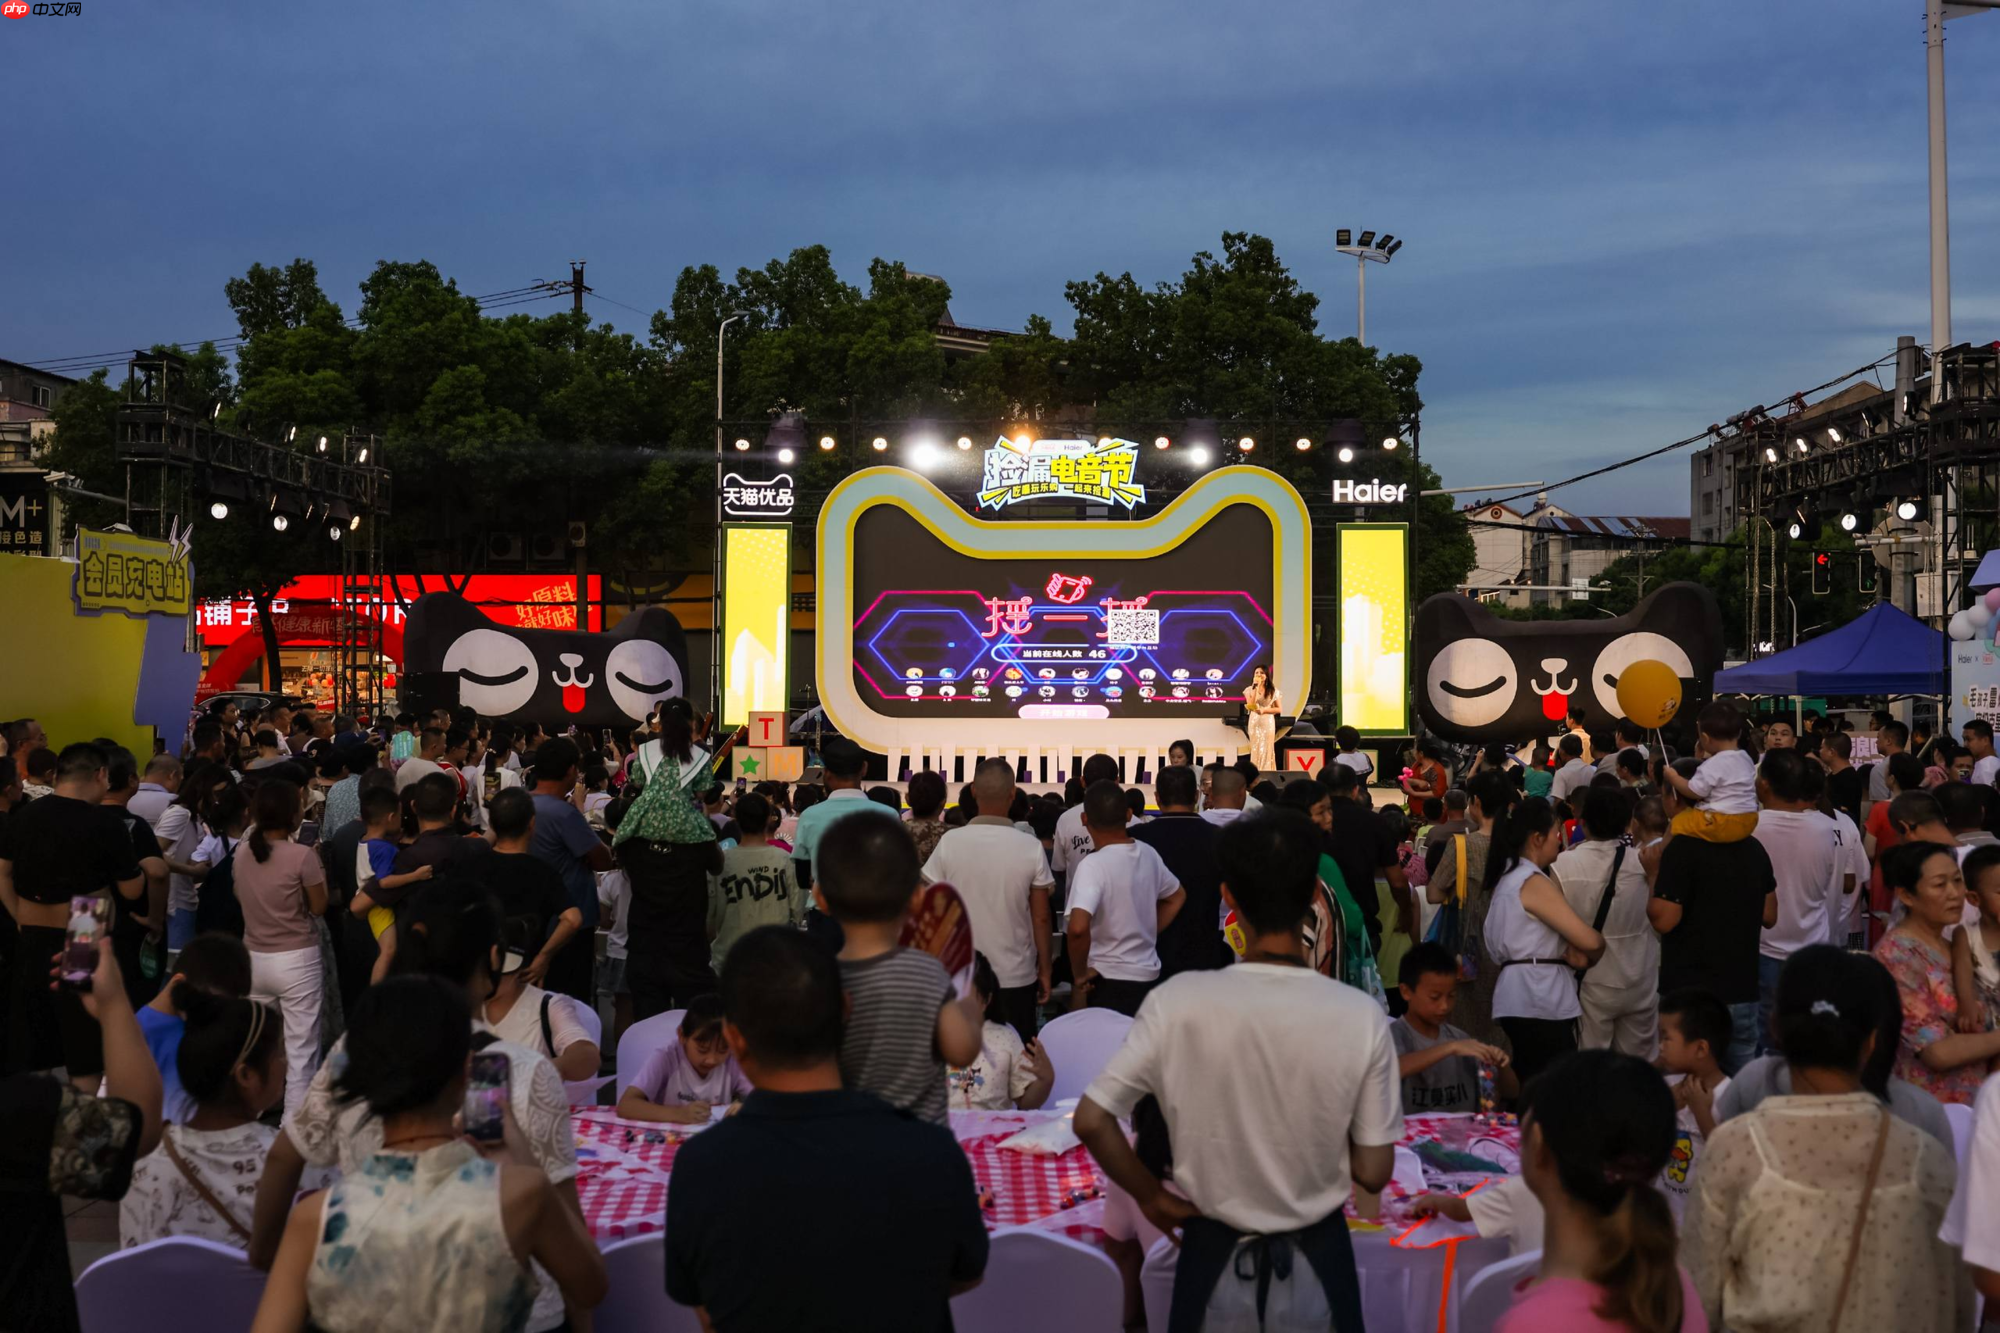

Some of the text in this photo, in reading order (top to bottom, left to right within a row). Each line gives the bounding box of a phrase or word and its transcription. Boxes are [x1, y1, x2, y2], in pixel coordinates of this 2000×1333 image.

[986, 451, 1133, 489] 捡漏电音节
[723, 487, 795, 506] 天猫优品
[1333, 478, 1408, 503] Haier
[83, 550, 185, 604] 会员充电站
[1022, 649, 1107, 659] 当前在线人数 46
[758, 717, 775, 740] T
[774, 753, 796, 776] M
[747, 865, 770, 875] WIND
[233, 1158, 256, 1175] 95
